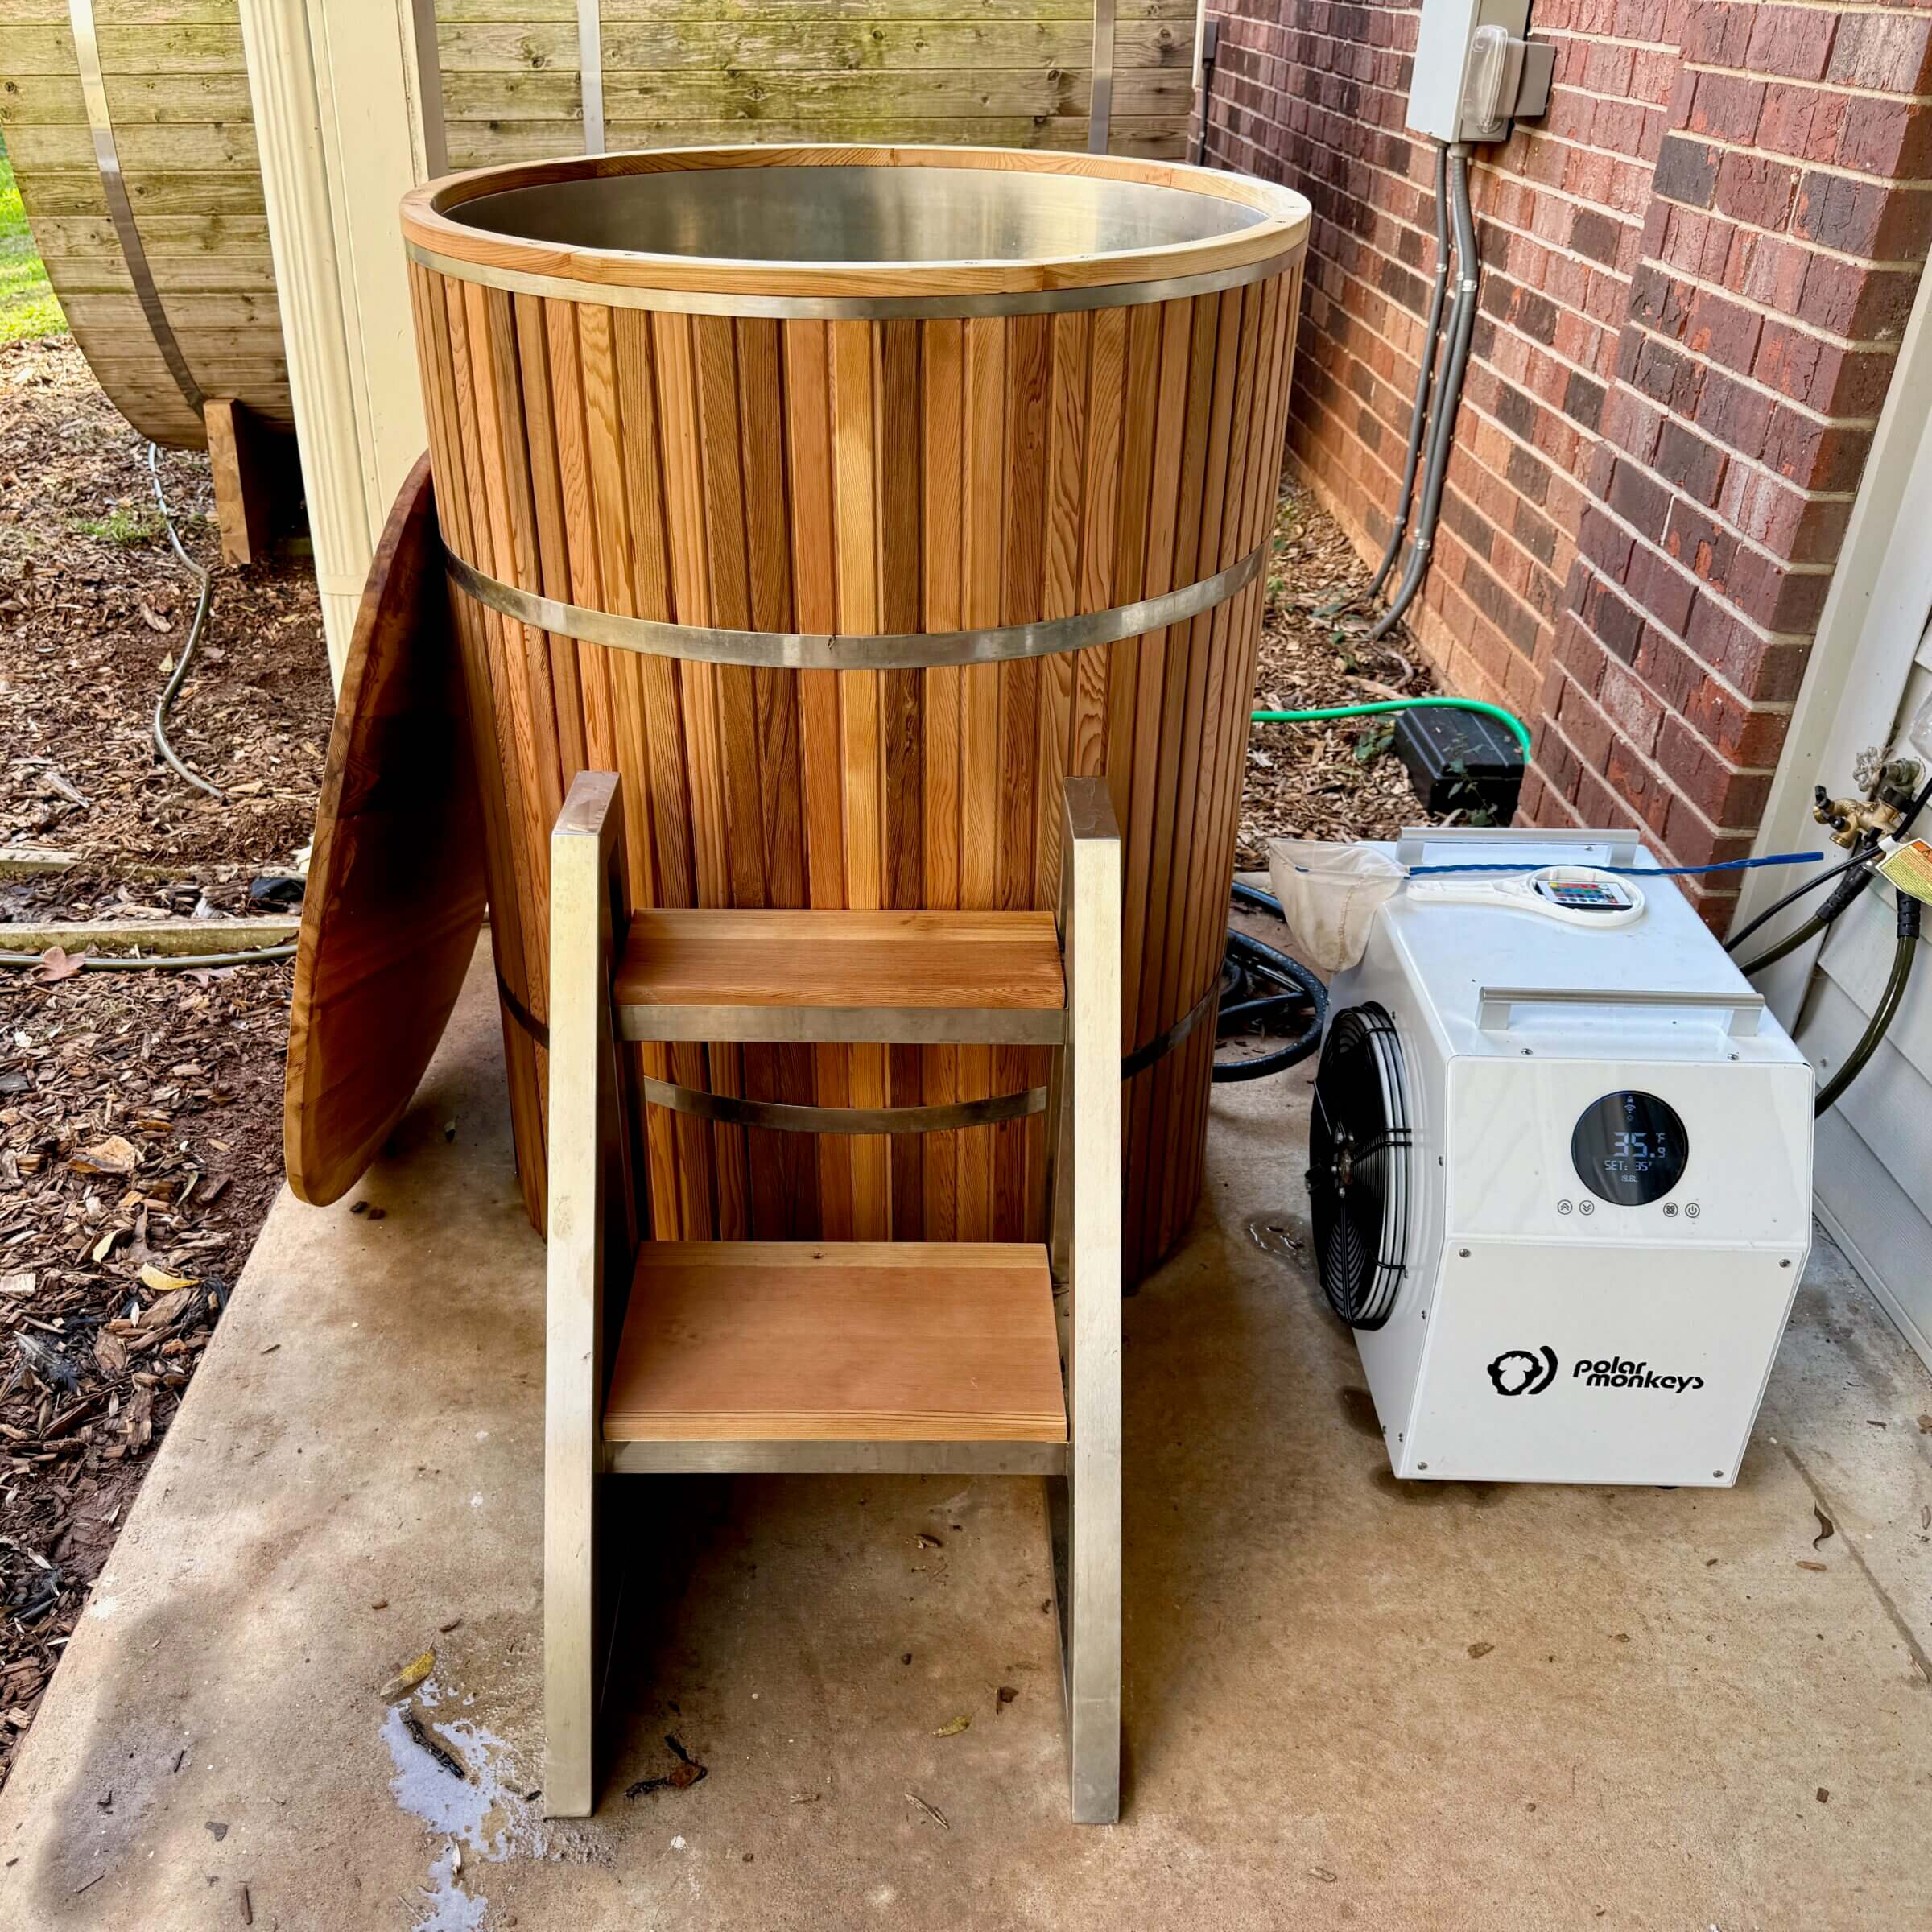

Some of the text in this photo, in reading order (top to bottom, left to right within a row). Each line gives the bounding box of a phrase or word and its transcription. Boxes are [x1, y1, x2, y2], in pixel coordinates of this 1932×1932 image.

[1604, 1160, 1628, 1171] SET:
[1572, 1356, 1647, 1377] polar
[1586, 1371, 1704, 1393] monkeys
